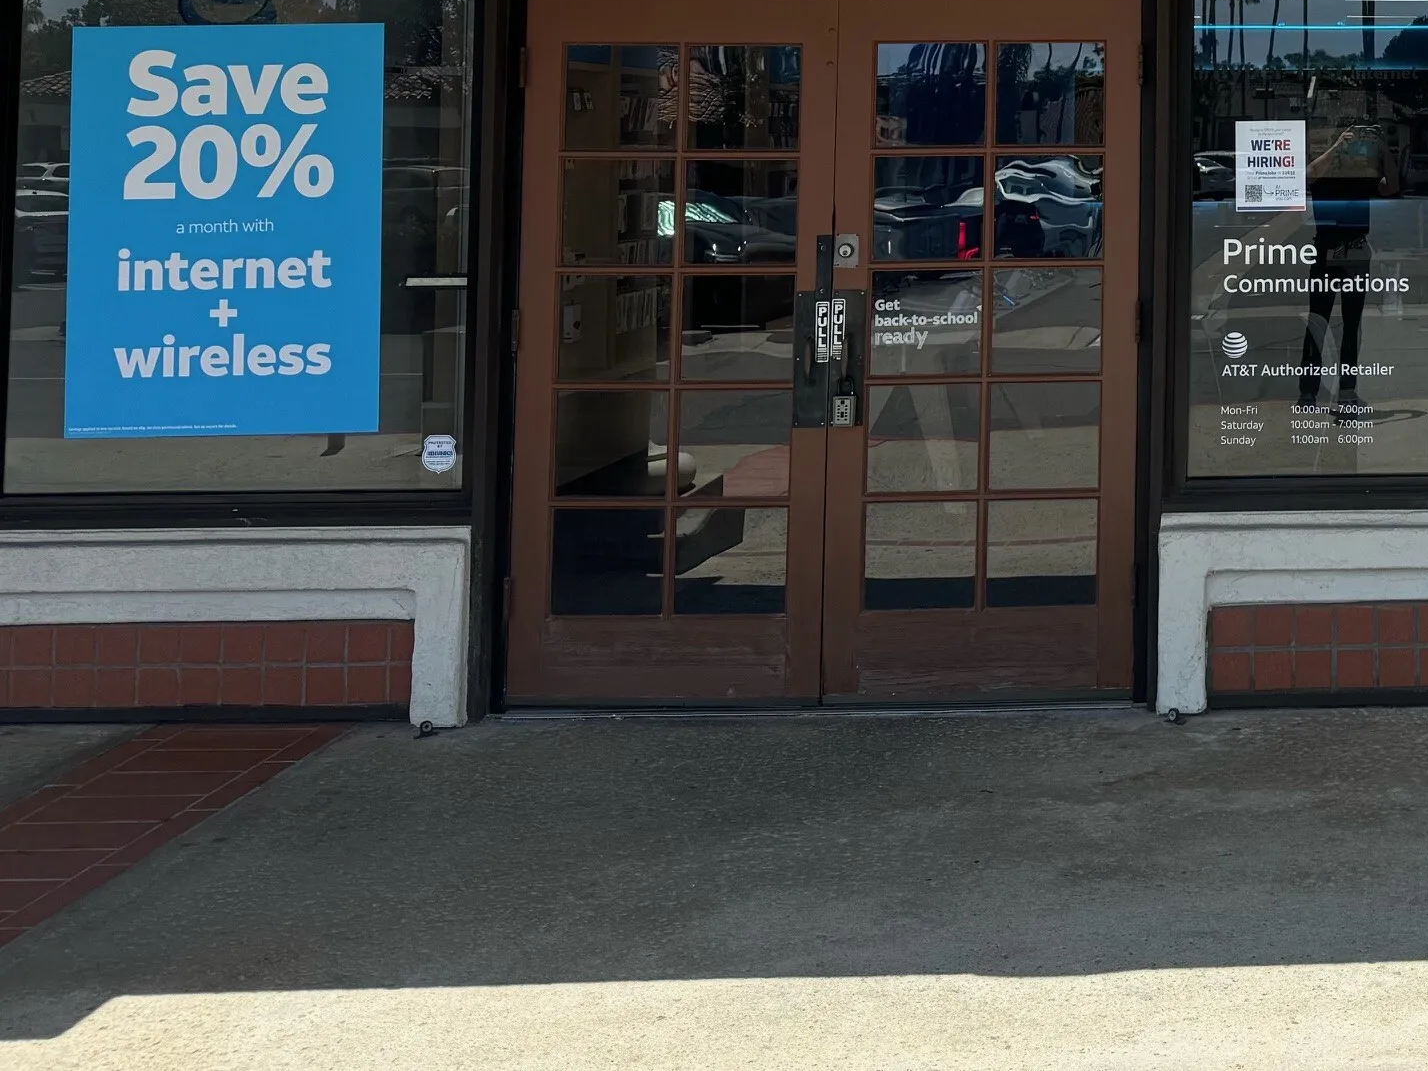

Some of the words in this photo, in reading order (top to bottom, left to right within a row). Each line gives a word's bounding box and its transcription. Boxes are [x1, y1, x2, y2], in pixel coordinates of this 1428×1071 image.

[126, 49, 330, 117] Save
[1250, 139, 1291, 151] WE'RE
[123, 123, 335, 200] 20%
[1247, 155, 1295, 168] HIRING!
[1275, 189, 1299, 197] PRIME
[176, 223, 185, 234] a
[189, 218, 239, 234] month
[242, 218, 274, 232] with
[1223, 237, 1318, 265] Prime
[117, 248, 332, 292] internet
[1223, 273, 1410, 293] Communications
[209, 299, 238, 327] +
[874, 299, 900, 311] Get
[817, 306, 828, 348] PULL
[833, 303, 844, 345] PULL
[874, 311, 978, 327] back-to-school
[874, 327, 928, 349] ready
[113, 333, 332, 379] wireless
[1222, 364, 1258, 377] AT&T
[1261, 363, 1337, 377] Authorized
[1341, 363, 1394, 376] Retailer
[1220, 405, 1258, 415] Mon-Fri
[1290, 405, 1330, 414] 10:00am
[1338, 404, 1374, 416] 7:00pm
[1220, 420, 1264, 431] Saturday
[1290, 420, 1330, 429] 10:00am
[1338, 419, 1374, 431] 7:00pm
[1220, 435, 1256, 446] Sunday
[1291, 435, 1329, 444] 11:00am
[1338, 434, 1373, 445] 6:00pm
